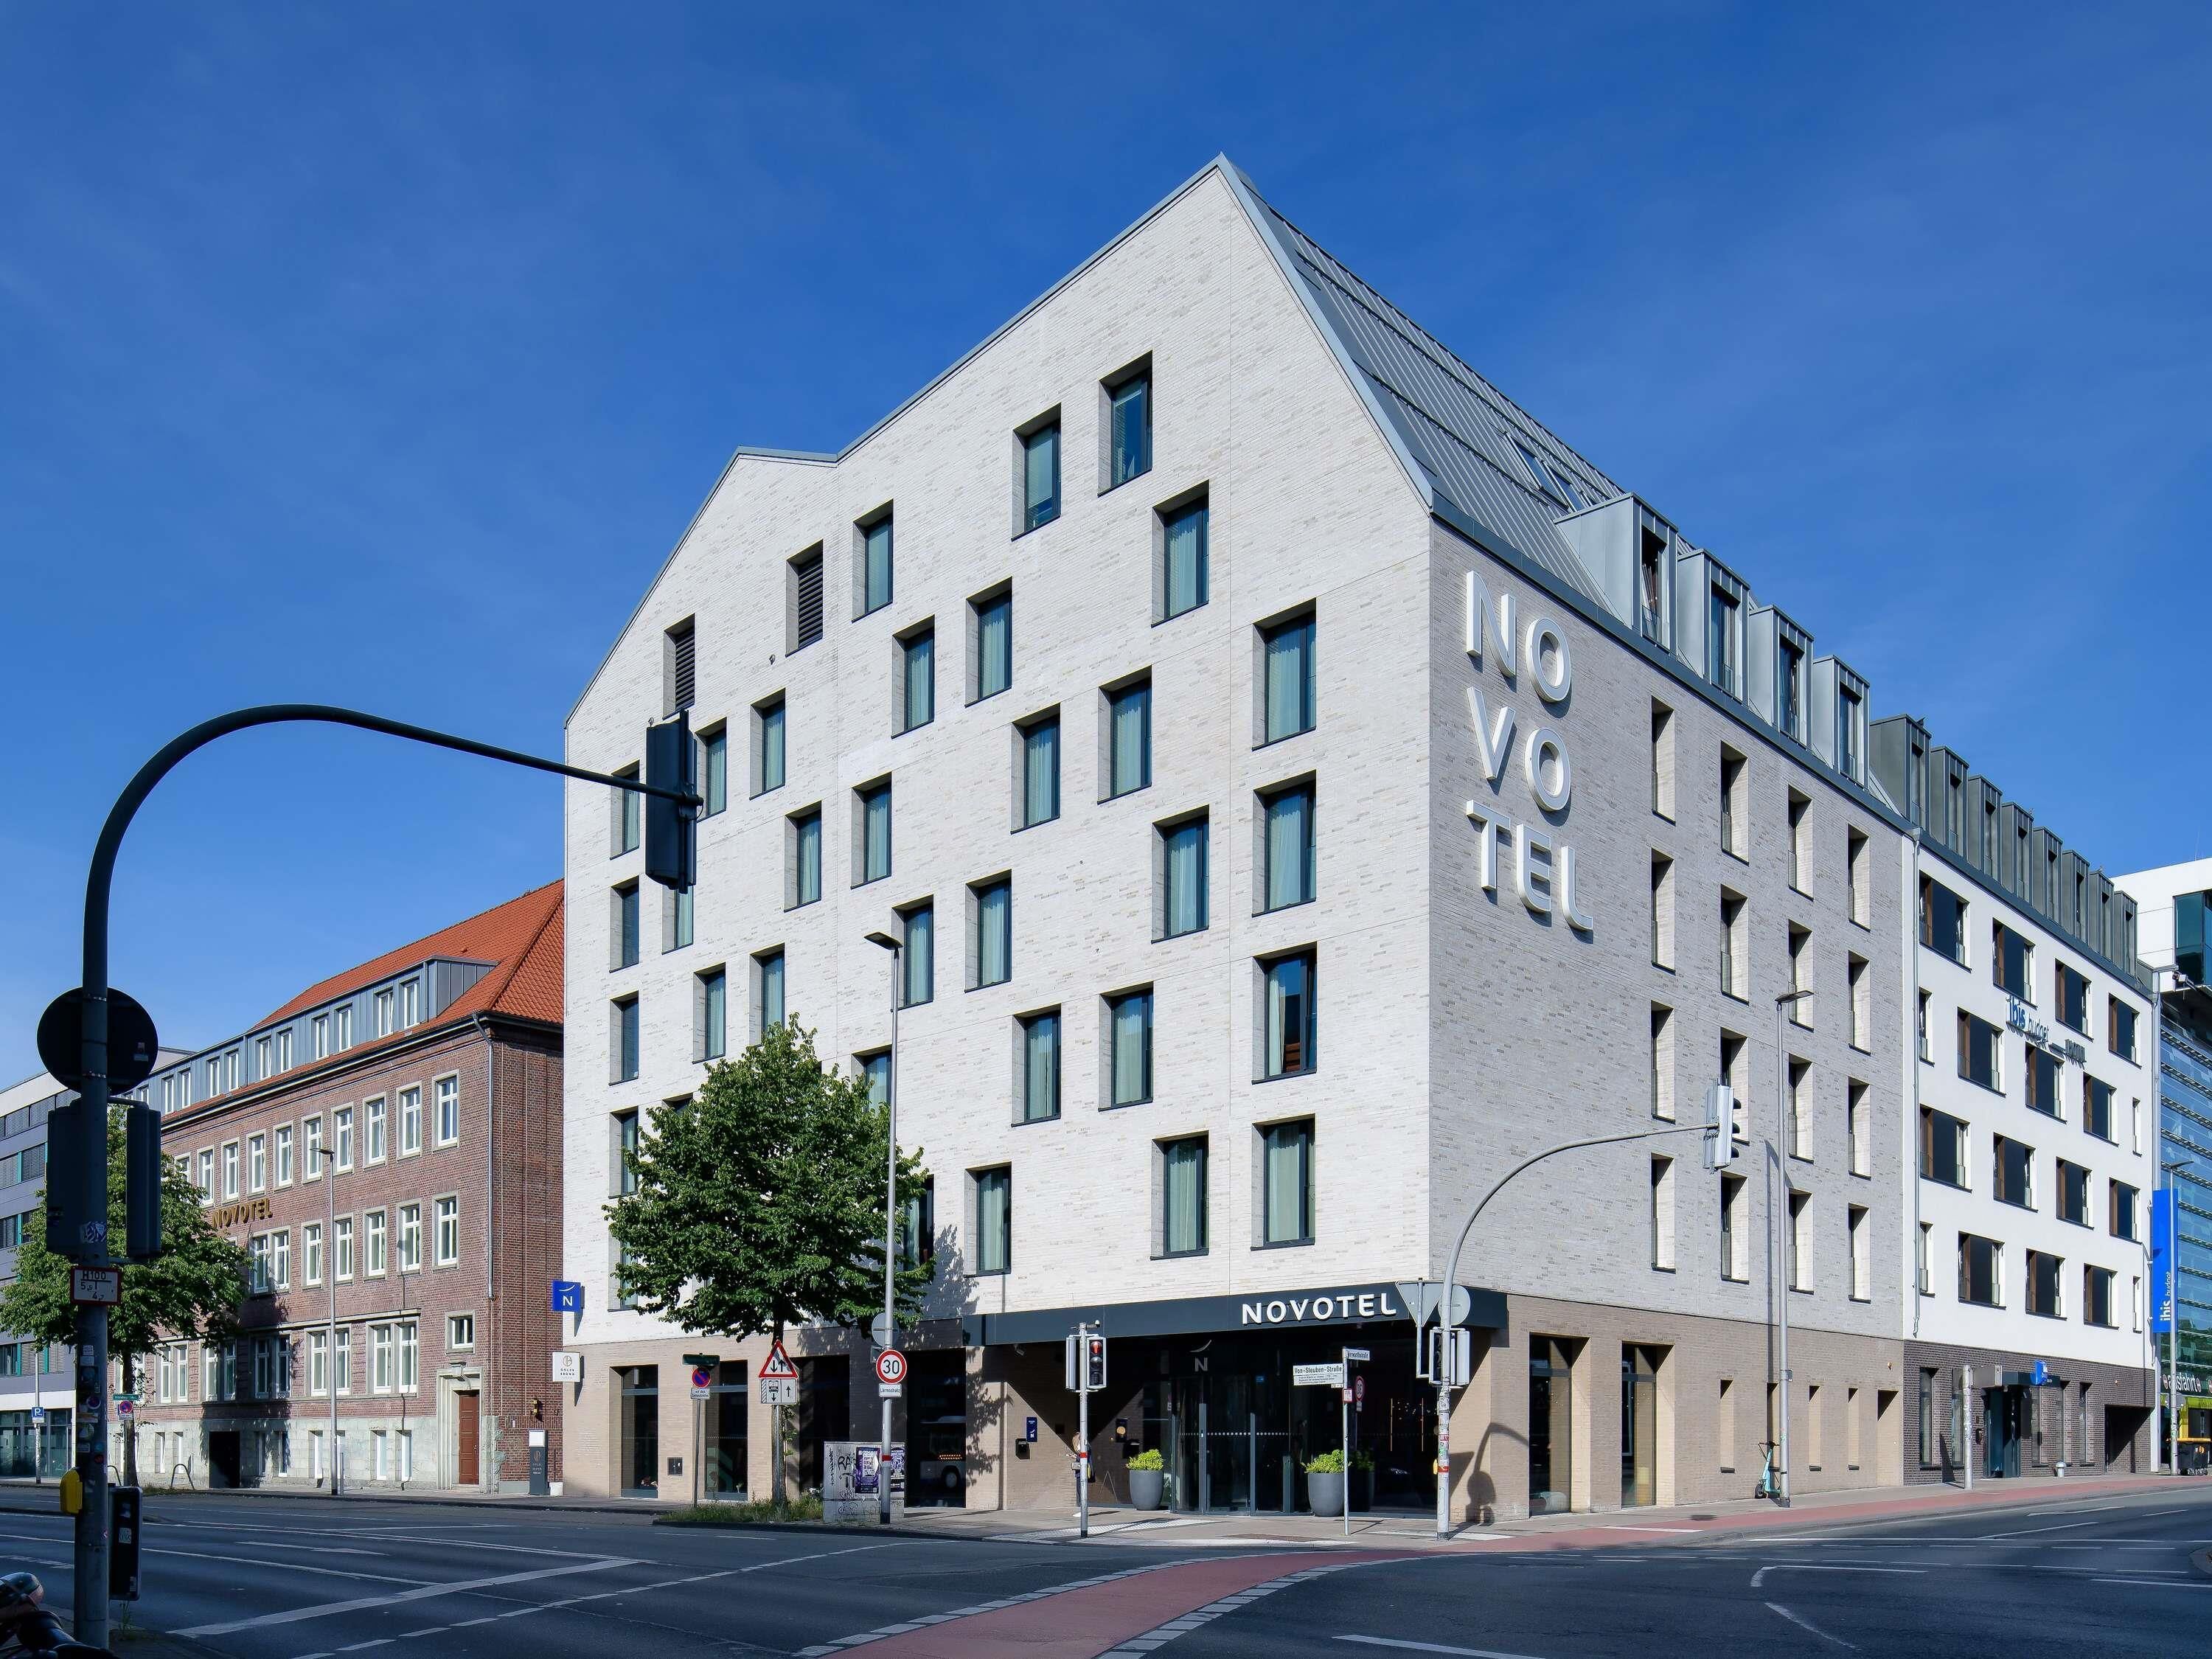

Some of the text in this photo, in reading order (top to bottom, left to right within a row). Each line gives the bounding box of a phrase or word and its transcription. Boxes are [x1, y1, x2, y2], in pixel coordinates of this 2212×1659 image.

[1466, 570, 1571, 703] NO
[1467, 686, 1571, 812] VO
[1466, 799, 1593, 931] TEL
[2009, 995, 2025, 1030] ibis
[212, 1197, 273, 1228] NOVOTEL
[83, 1270, 106, 1280] H100
[563, 1295, 573, 1307] N
[1242, 1293, 1397, 1326] NOVOTEL
[883, 1359, 900, 1375] 30
[1194, 1357, 1208, 1372] N
[2168, 1372, 2197, 1392] asfahrt
[34, 1408, 41, 1416] P
